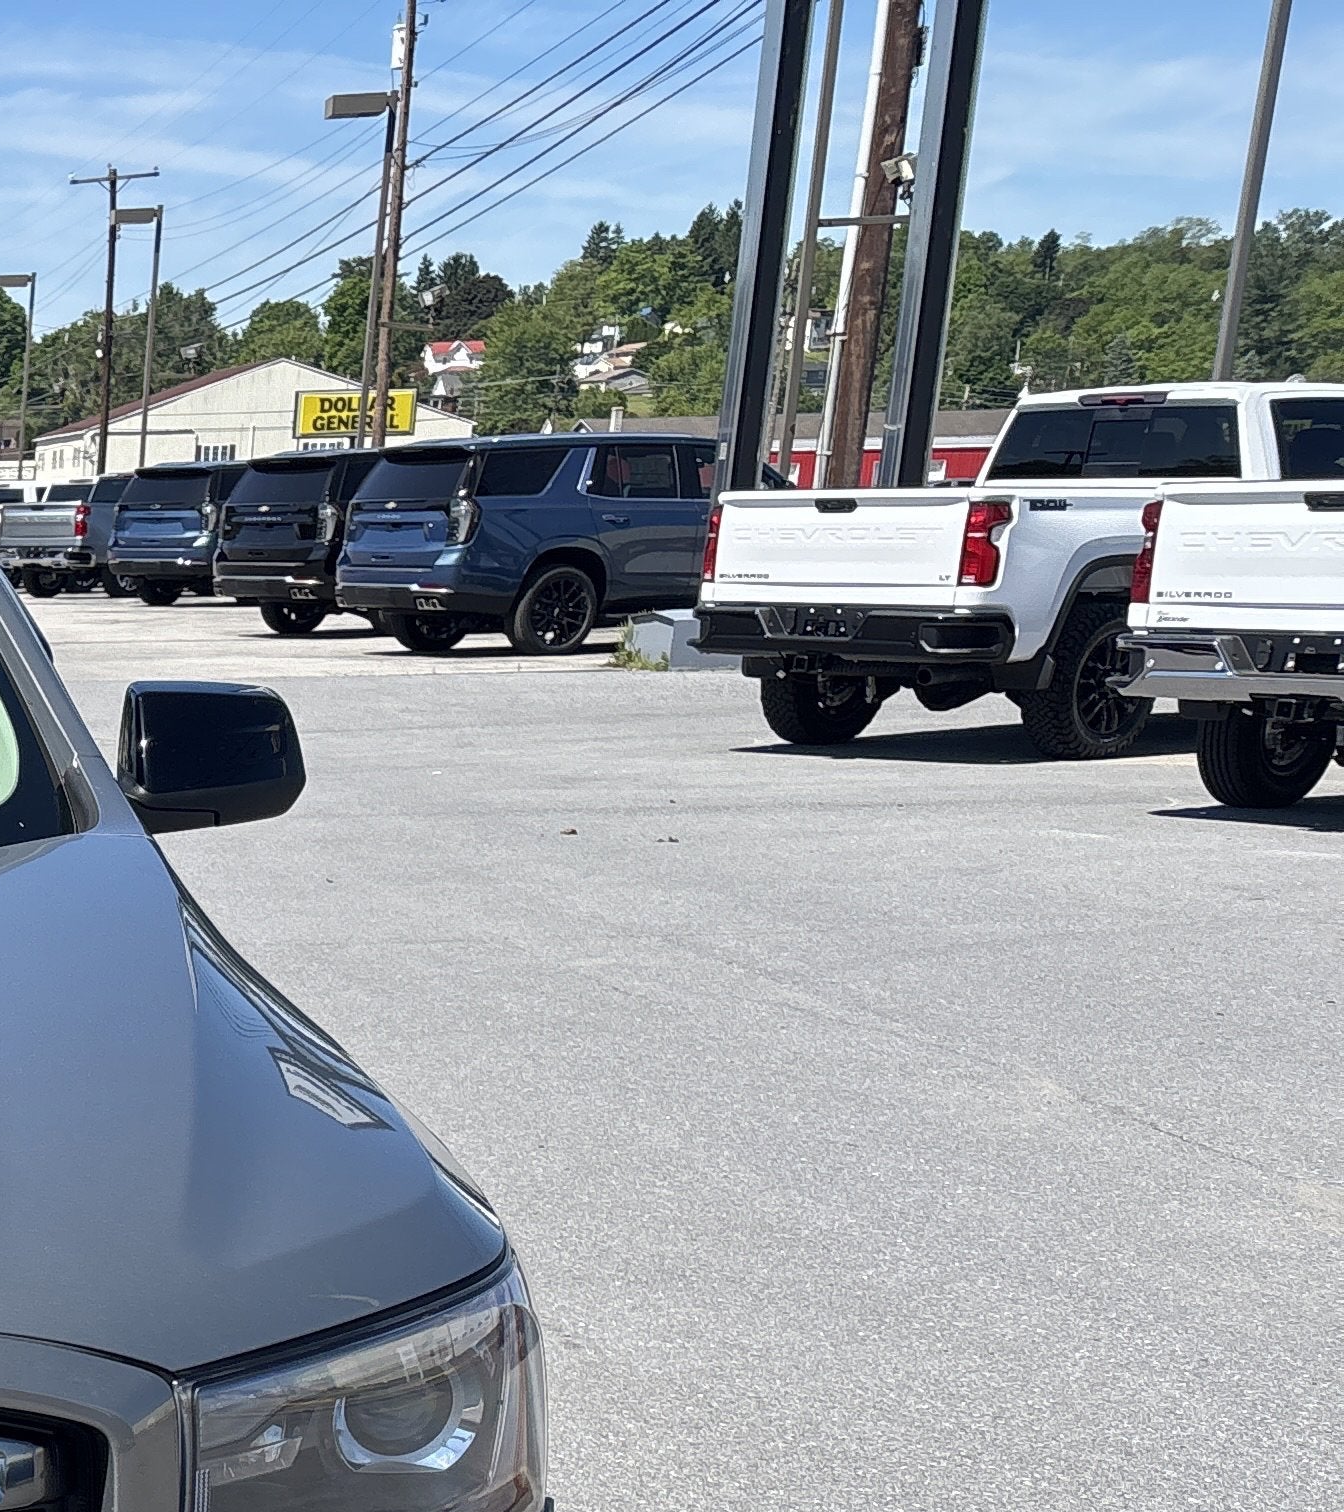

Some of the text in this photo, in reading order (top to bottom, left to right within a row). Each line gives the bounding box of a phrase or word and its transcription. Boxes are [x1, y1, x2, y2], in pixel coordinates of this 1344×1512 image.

[312, 414, 399, 431] GENERL
[731, 526, 945, 545] CHEVROLET
[1156, 591, 1233, 599] SILVERADO
